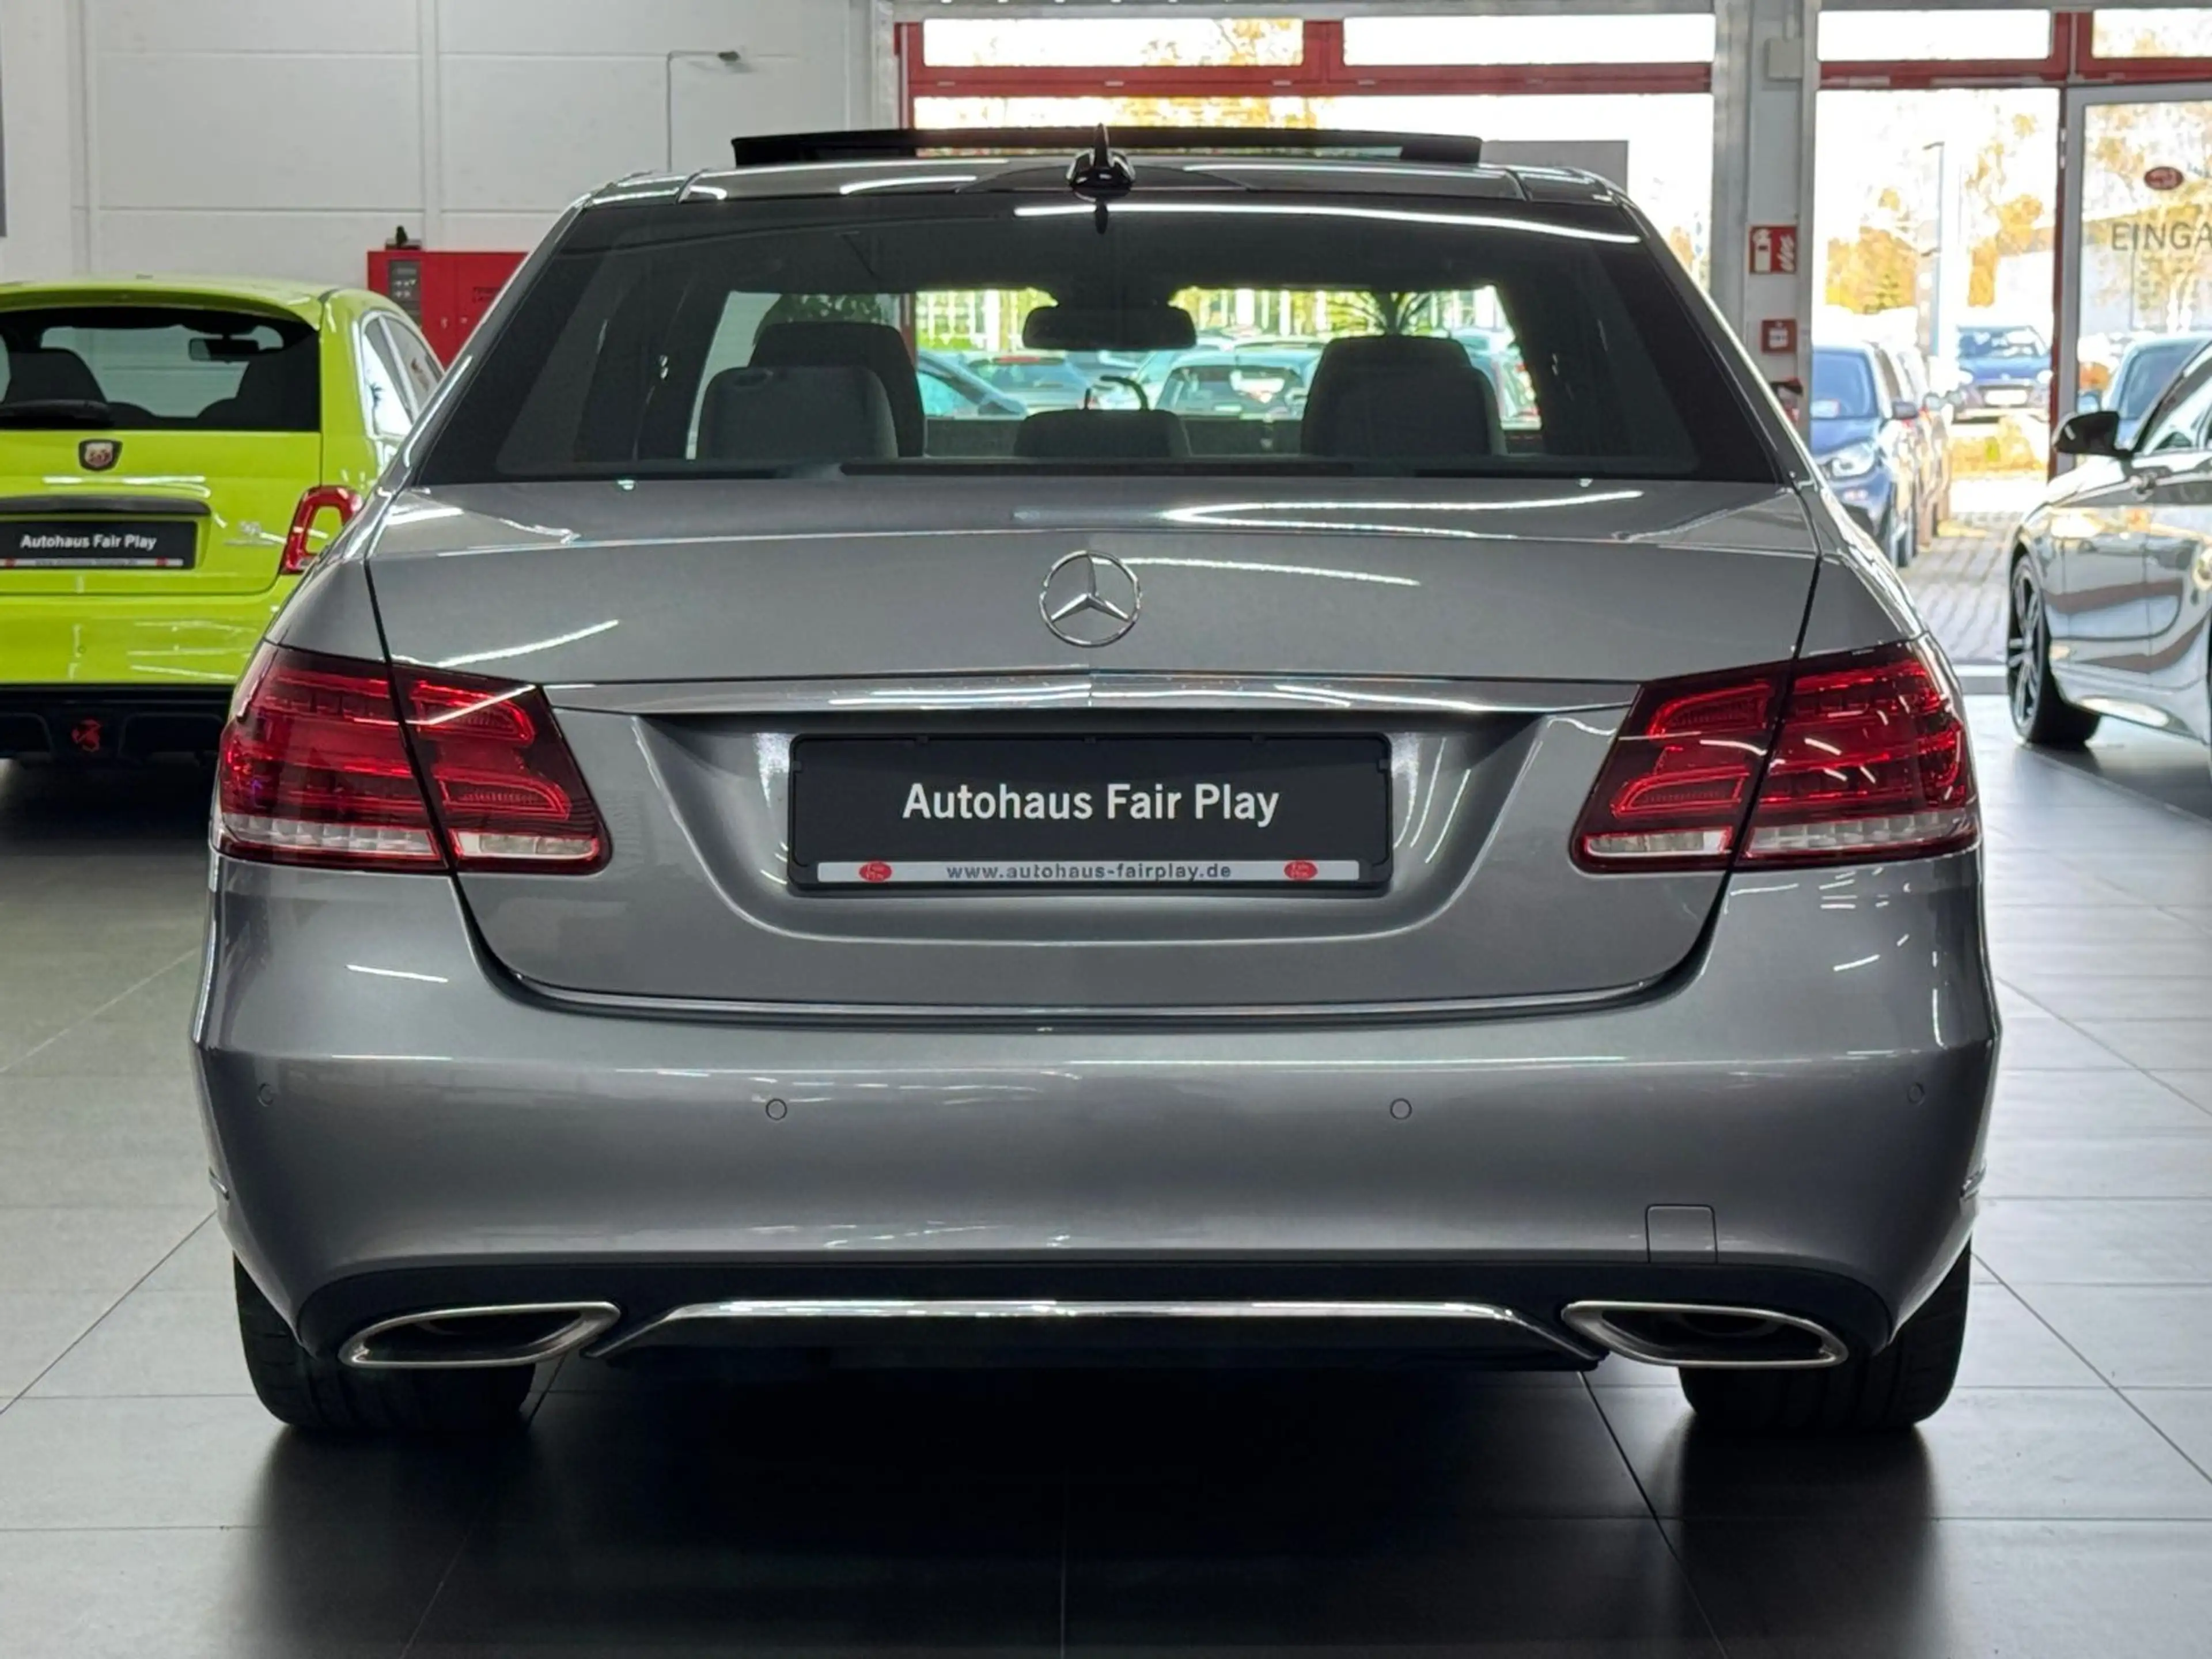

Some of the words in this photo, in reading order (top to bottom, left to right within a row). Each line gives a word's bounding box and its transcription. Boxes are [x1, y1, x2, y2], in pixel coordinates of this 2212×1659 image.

[20, 535, 90, 548] Autohaus
[93, 534, 122, 548] Fair
[124, 534, 157, 551] Play
[902, 782, 1093, 820] Autohaus
[1107, 783, 1182, 819] Fair
[1195, 783, 1279, 828] Play
[946, 863, 1231, 881] www.autohaus-fairplay.de
